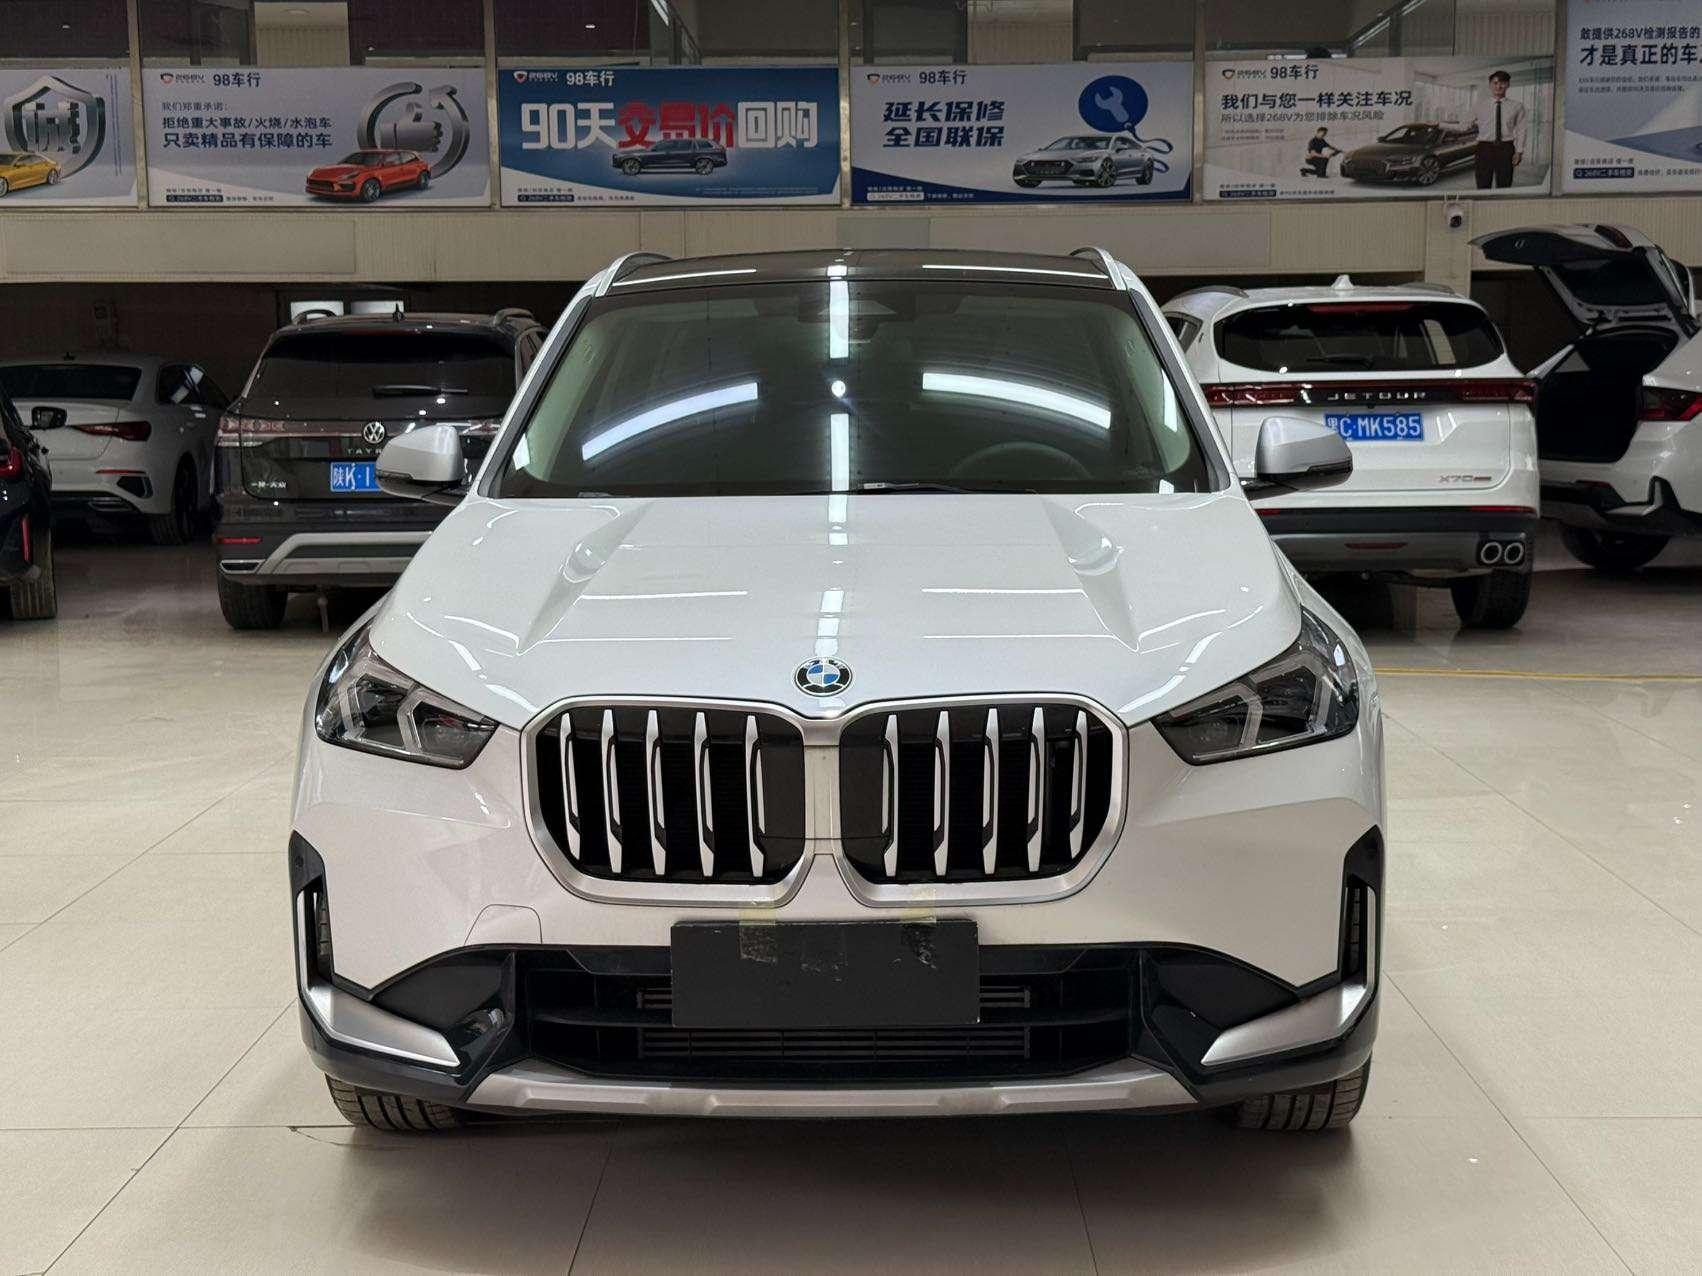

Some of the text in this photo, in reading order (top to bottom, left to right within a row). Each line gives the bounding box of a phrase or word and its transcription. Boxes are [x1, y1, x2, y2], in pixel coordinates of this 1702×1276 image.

[1580, 27, 1700, 40] 敢提供268V检测报告的
[213, 72, 262, 88] 98车行
[566, 70, 615, 87] 98车行
[919, 69, 966, 85] 98车行
[1270, 64, 1319, 80] 98车行
[1220, 90, 1414, 110] 我们与您一样关注车况
[883, 101, 1005, 123] 延长保修
[162, 116, 332, 130] 拒绝重大事故/火烧/水泡车
[163, 132, 333, 149] 只卖精品有保障的车
[882, 126, 1005, 148] 全国联保
[1327, 392, 1427, 401] JETOUR
